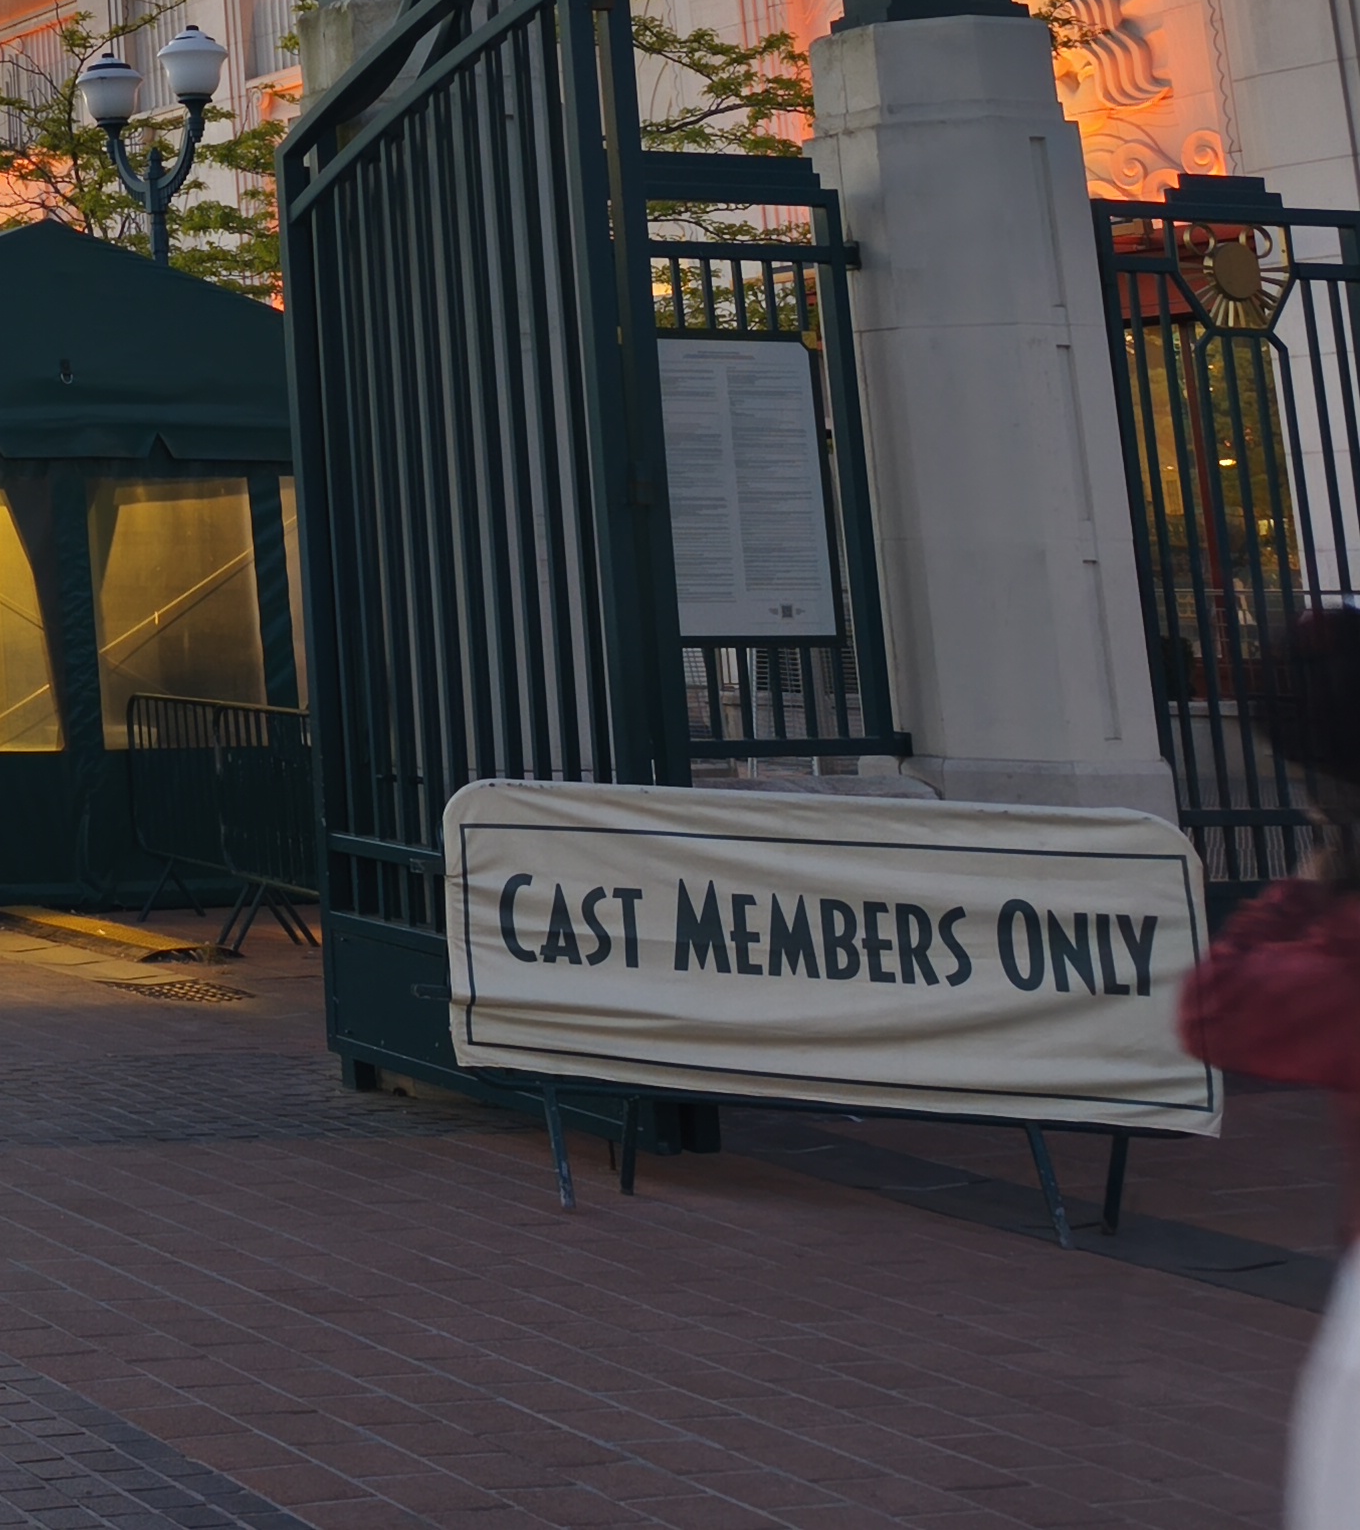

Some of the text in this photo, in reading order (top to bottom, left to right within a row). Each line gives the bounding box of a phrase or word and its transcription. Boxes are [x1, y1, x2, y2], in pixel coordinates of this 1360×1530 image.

[498, 872, 1159, 997] CAST MEMBERS ONLY
